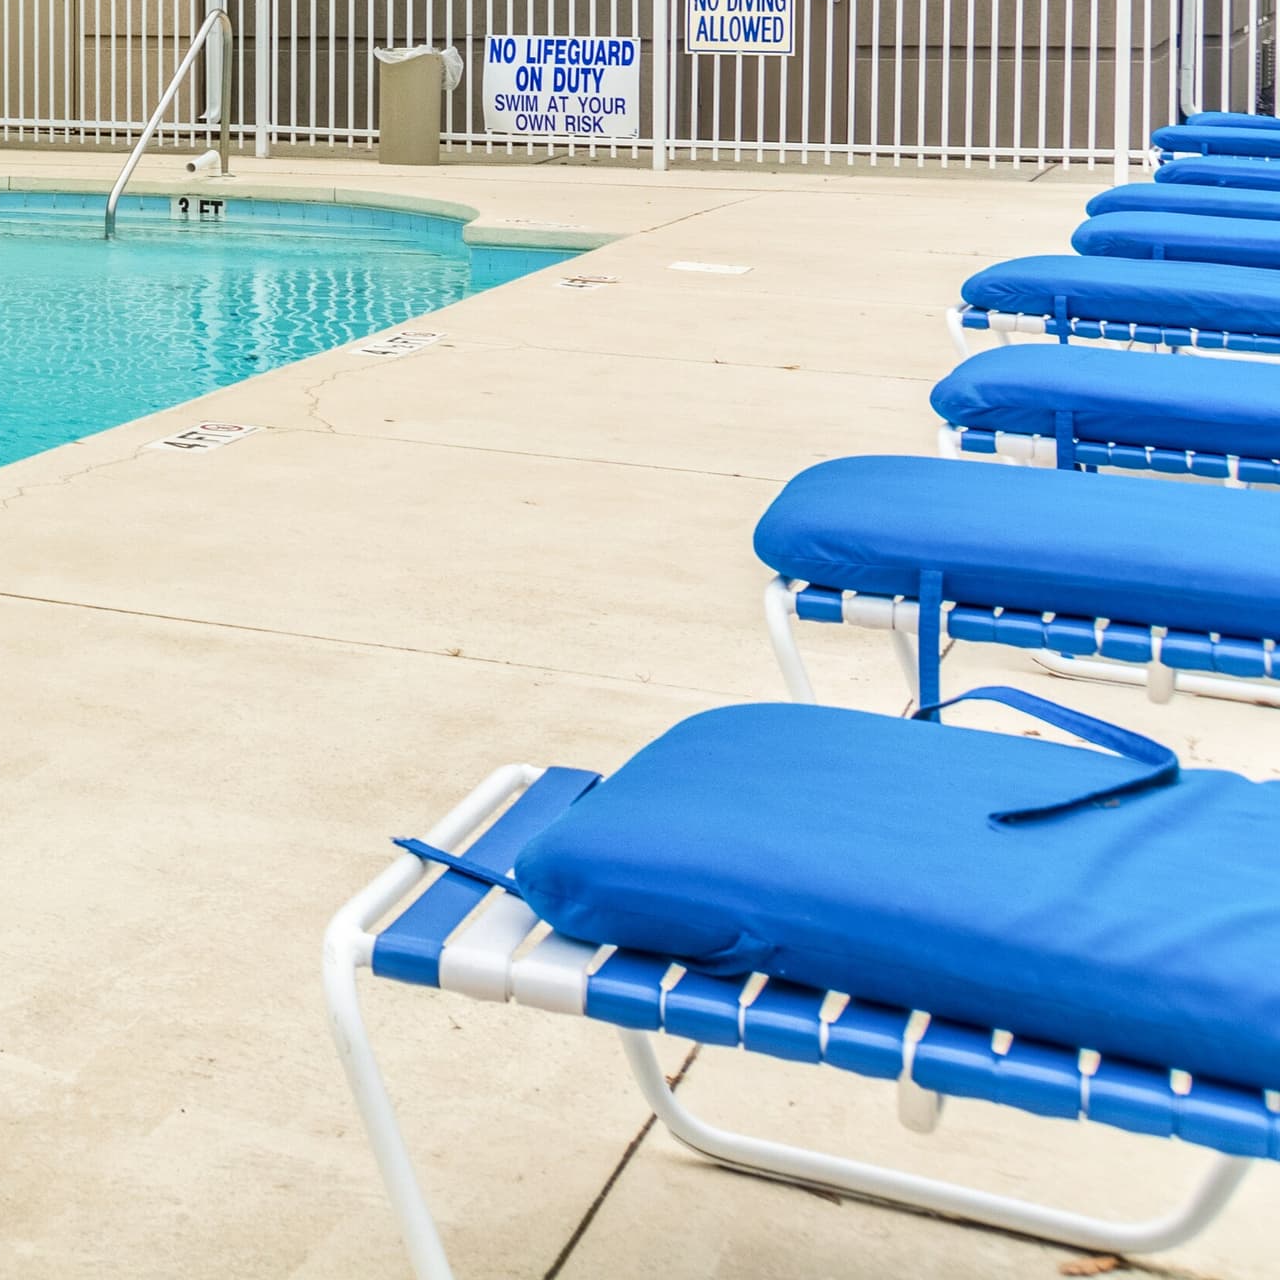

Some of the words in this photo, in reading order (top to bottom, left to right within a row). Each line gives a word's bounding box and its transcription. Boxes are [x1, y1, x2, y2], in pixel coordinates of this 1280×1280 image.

[696, 16, 784, 43] ALLOWED
[489, 38, 516, 64] NO
[526, 38, 634, 66] LIFEGUARD
[516, 66, 542, 92] ON
[553, 67, 605, 93] DUTY
[494, 94, 538, 112] SWIM
[547, 96, 569, 112] AT
[578, 97, 626, 115] YOUR
[516, 114, 555, 131] OWN
[565, 115, 604, 133] RISK
[163, 441, 208, 449] 4
[176, 431, 233, 443] FT
